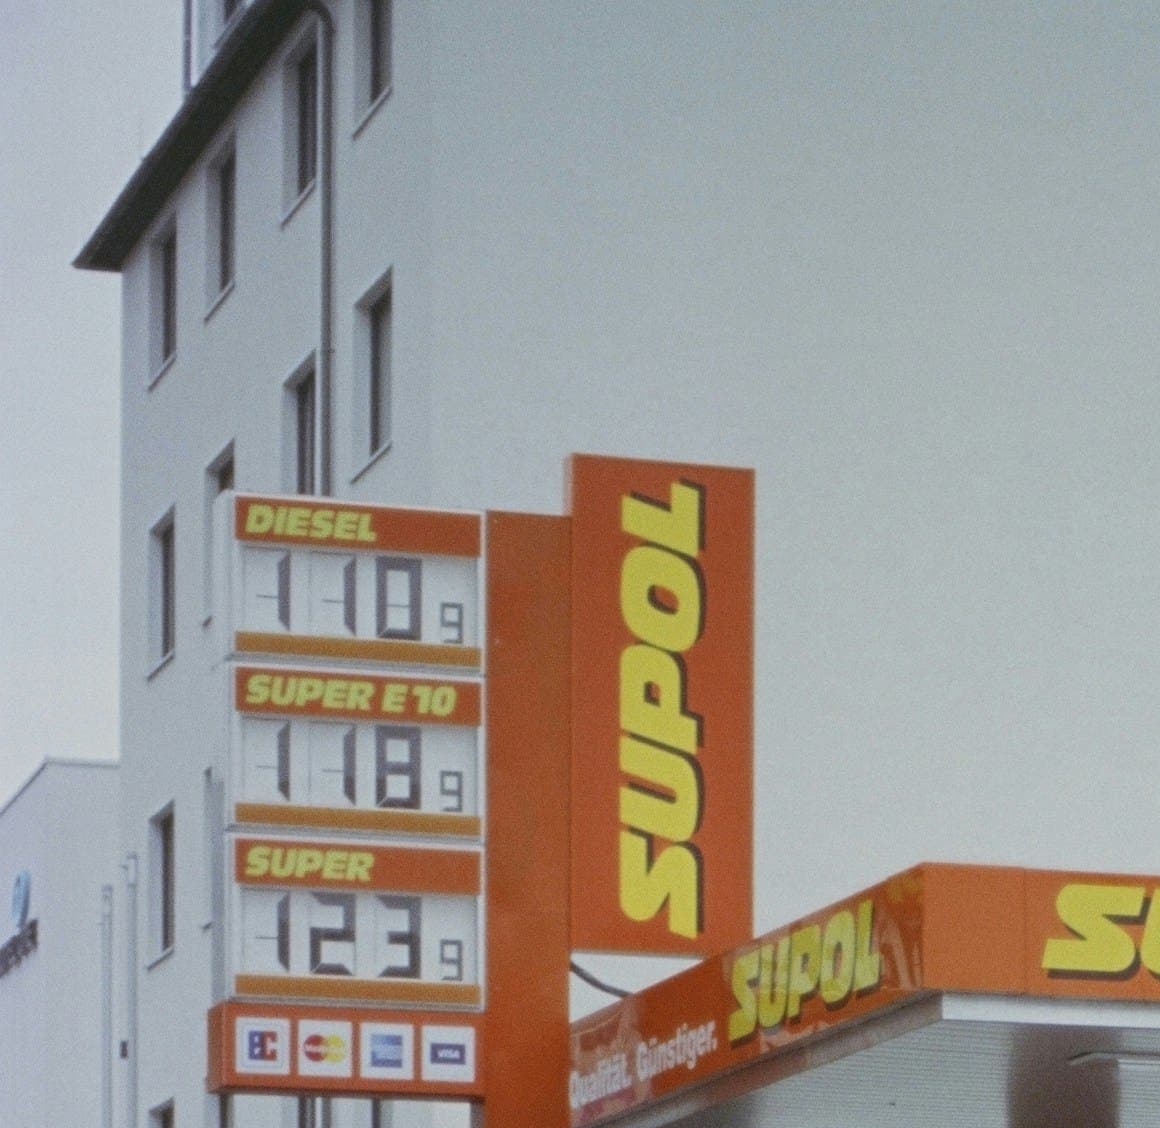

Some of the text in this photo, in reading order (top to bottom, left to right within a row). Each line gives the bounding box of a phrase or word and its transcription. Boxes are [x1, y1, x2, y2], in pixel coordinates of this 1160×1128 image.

[245, 505, 377, 542] DIESEL
[246, 674, 375, 711] SUPER
[619, 480, 704, 940] SUPOL
[245, 846, 375, 882] SUPER
[728, 899, 881, 1043] SUPOL
